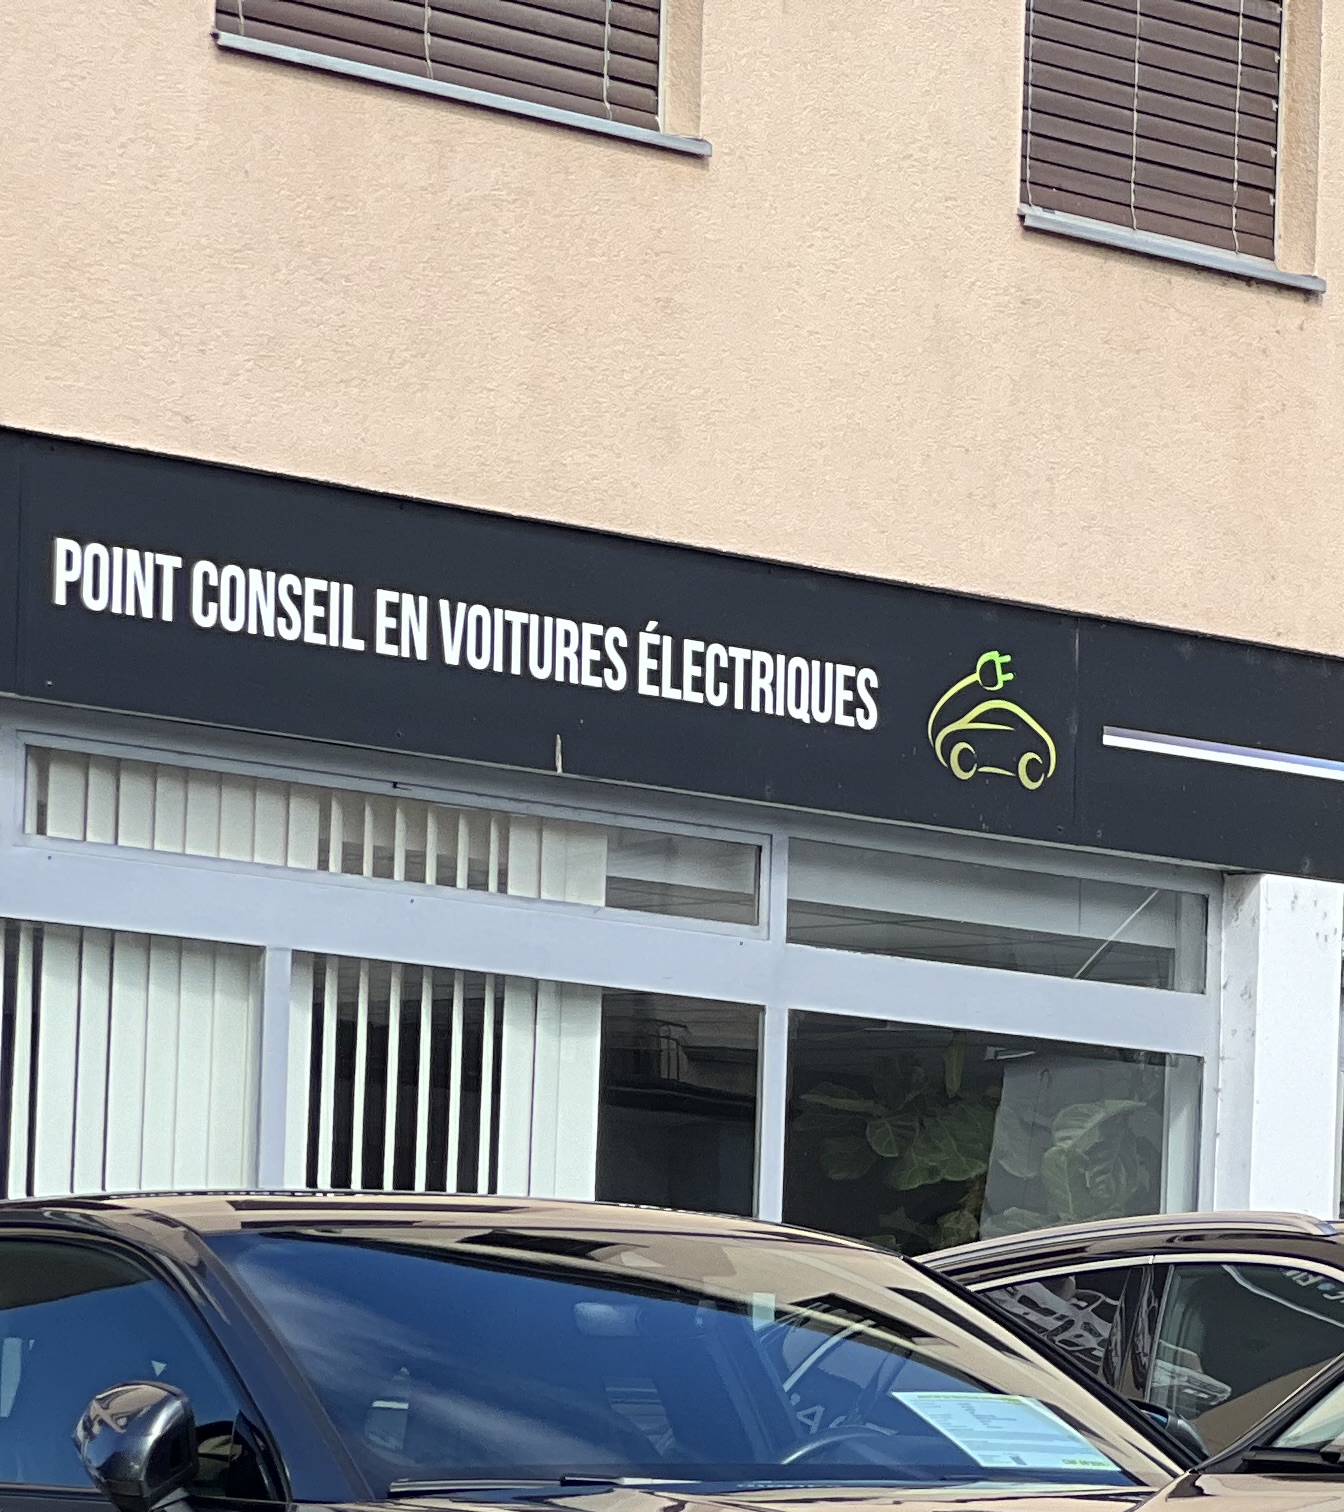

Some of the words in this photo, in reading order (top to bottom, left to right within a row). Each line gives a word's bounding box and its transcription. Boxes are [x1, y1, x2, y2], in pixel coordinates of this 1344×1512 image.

[54, 537, 182, 622] POINT
[191, 560, 365, 653] CONSEIL
[375, 588, 428, 662] EN
[439, 598, 627, 692] VOITURES
[638, 620, 880, 731] ÉLECTRIQUES
